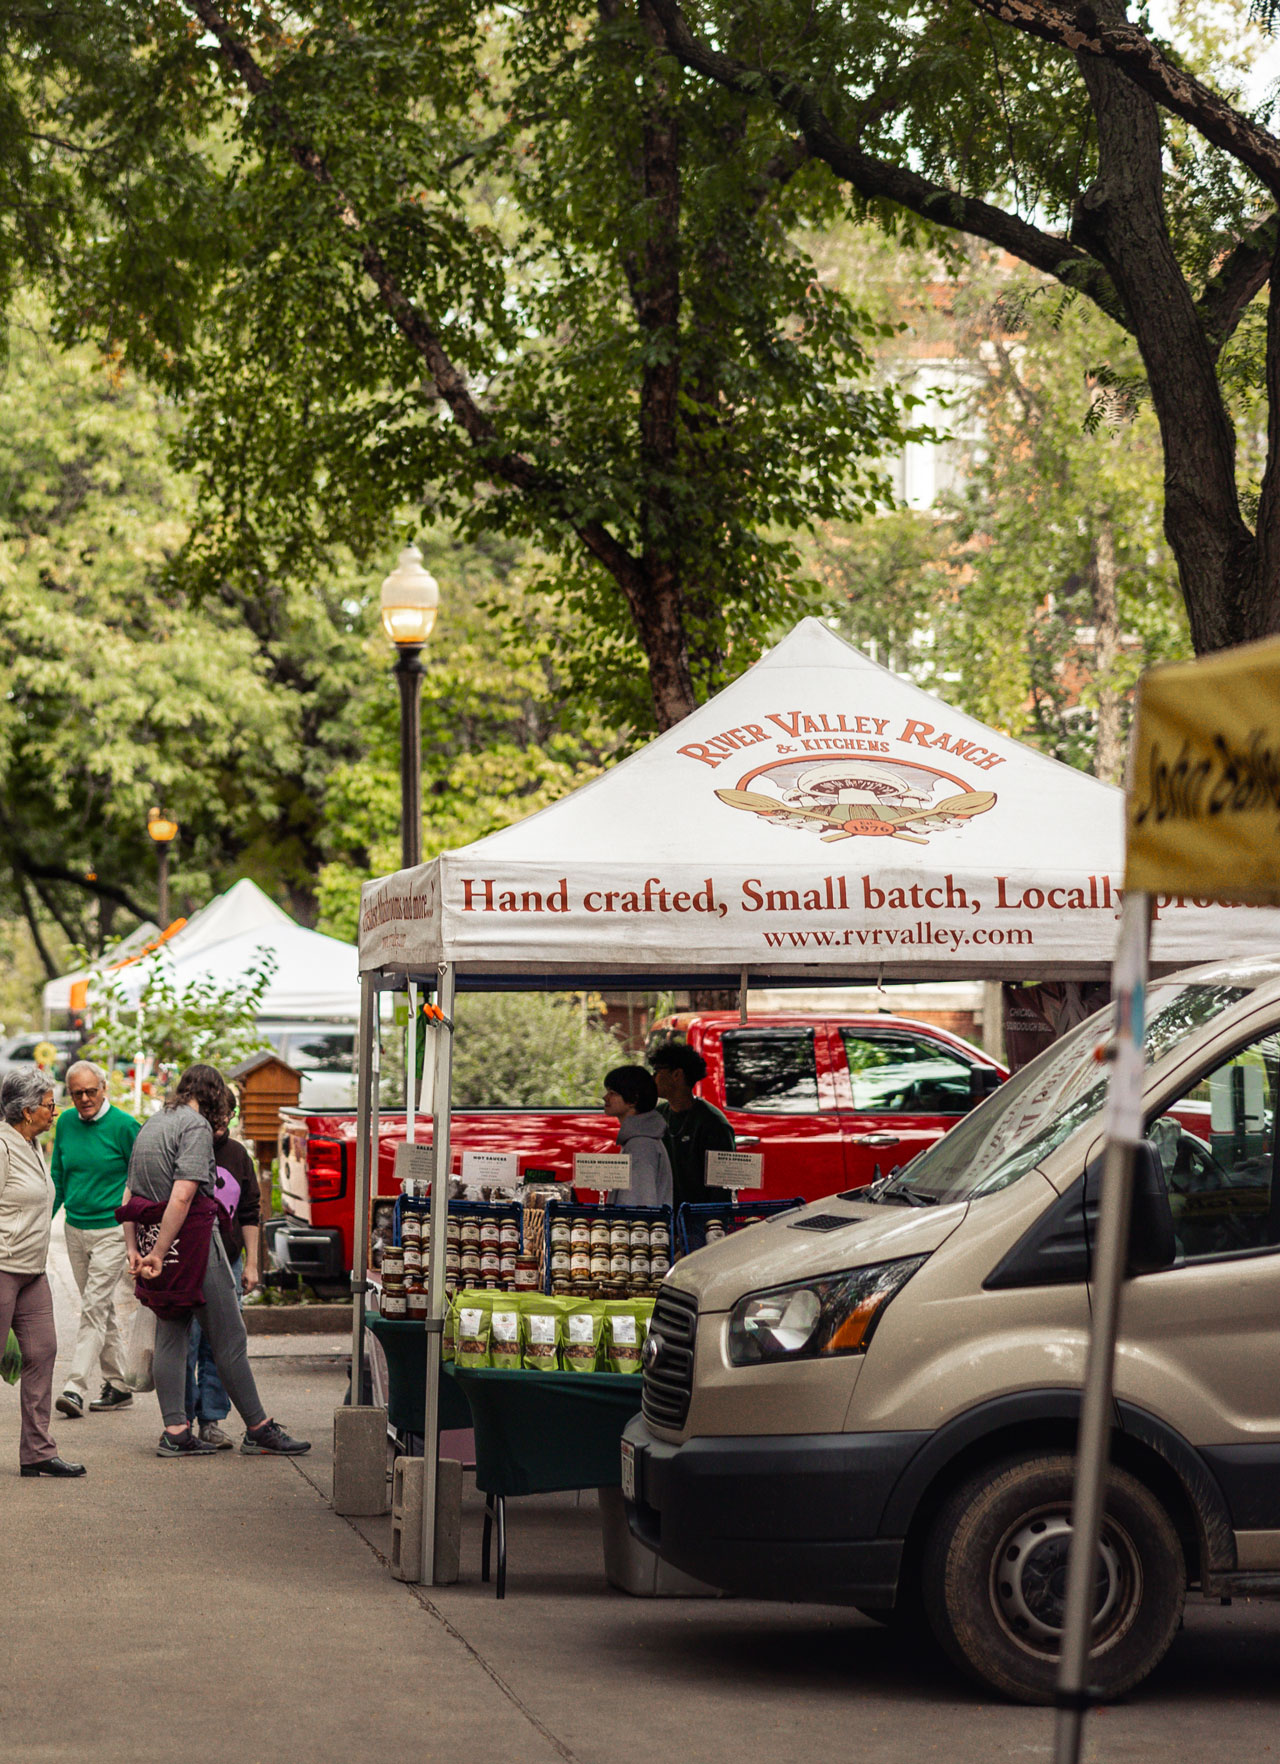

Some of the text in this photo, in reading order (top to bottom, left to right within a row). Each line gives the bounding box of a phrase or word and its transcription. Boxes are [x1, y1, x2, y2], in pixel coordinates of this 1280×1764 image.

[765, 710, 891, 739] VALLEY
[896, 718, 1007, 771] RANCH
[776, 738, 891, 754] & KITCHENS
[853, 825, 890, 833] 1976
[460, 878, 572, 913] Hand
[583, 877, 728, 918] crafted,
[741, 875, 851, 912] Small
[860, 874, 981, 914] batch,
[762, 921, 1034, 952] www.rvrvalley.com
